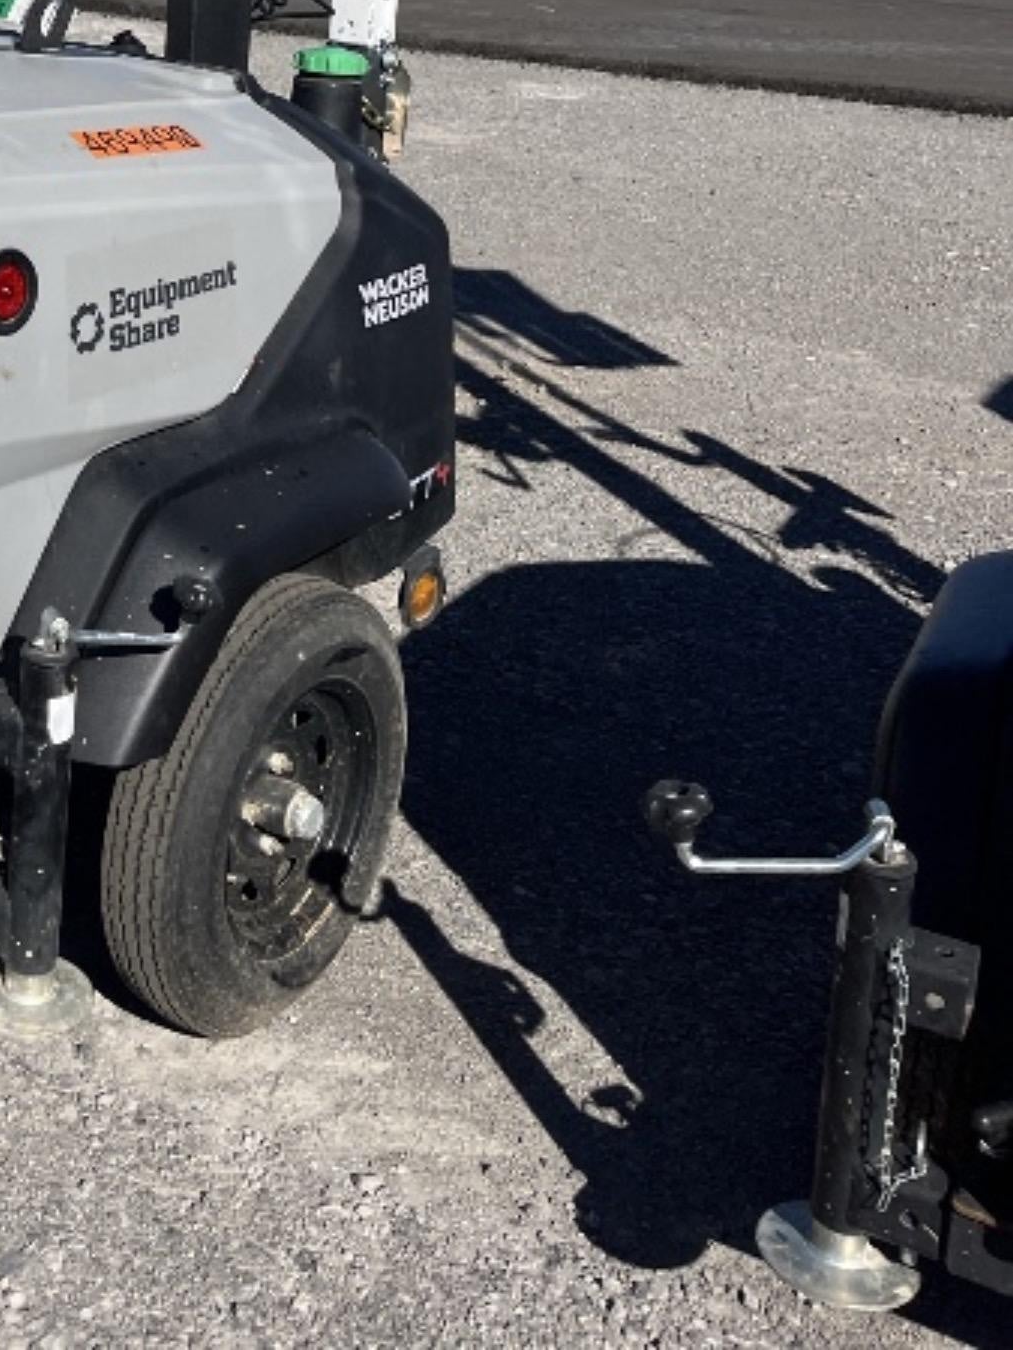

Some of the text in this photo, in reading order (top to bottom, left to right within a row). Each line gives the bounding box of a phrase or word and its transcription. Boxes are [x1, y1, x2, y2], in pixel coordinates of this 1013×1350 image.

[109, 260, 237, 318] Equipment
[358, 263, 428, 304] WACKER
[364, 284, 429, 328] NEUSON
[109, 314, 181, 351] Share
